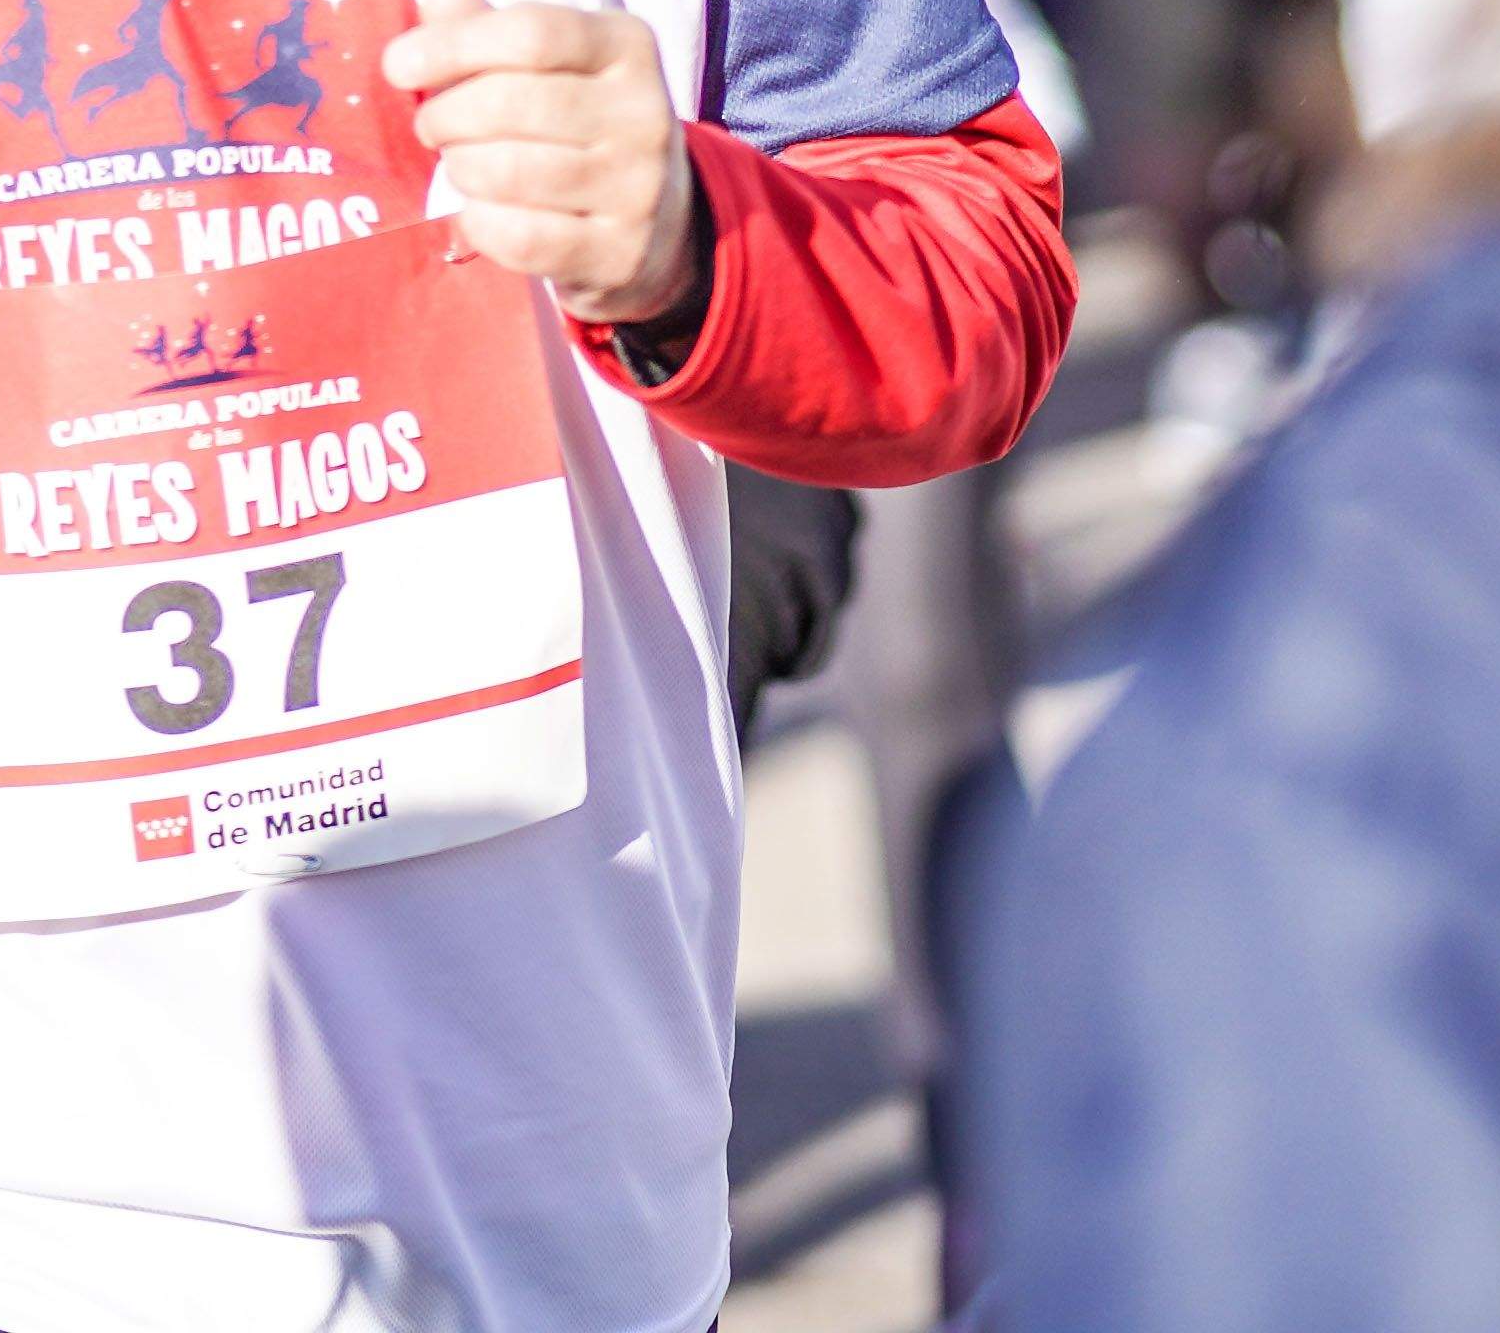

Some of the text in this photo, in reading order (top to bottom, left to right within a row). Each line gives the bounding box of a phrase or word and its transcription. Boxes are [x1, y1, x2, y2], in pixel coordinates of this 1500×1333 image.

[171, 144, 333, 176] POPULAR
[137, 189, 162, 211] de
[49, 376, 360, 448] CARRERA POPULAR
[188, 427, 243, 451] de los
[217, 411, 427, 537] MAGOS
[121, 552, 346, 736] 37
[204, 759, 384, 812] Comunidad
[208, 793, 389, 849] de Madrid
